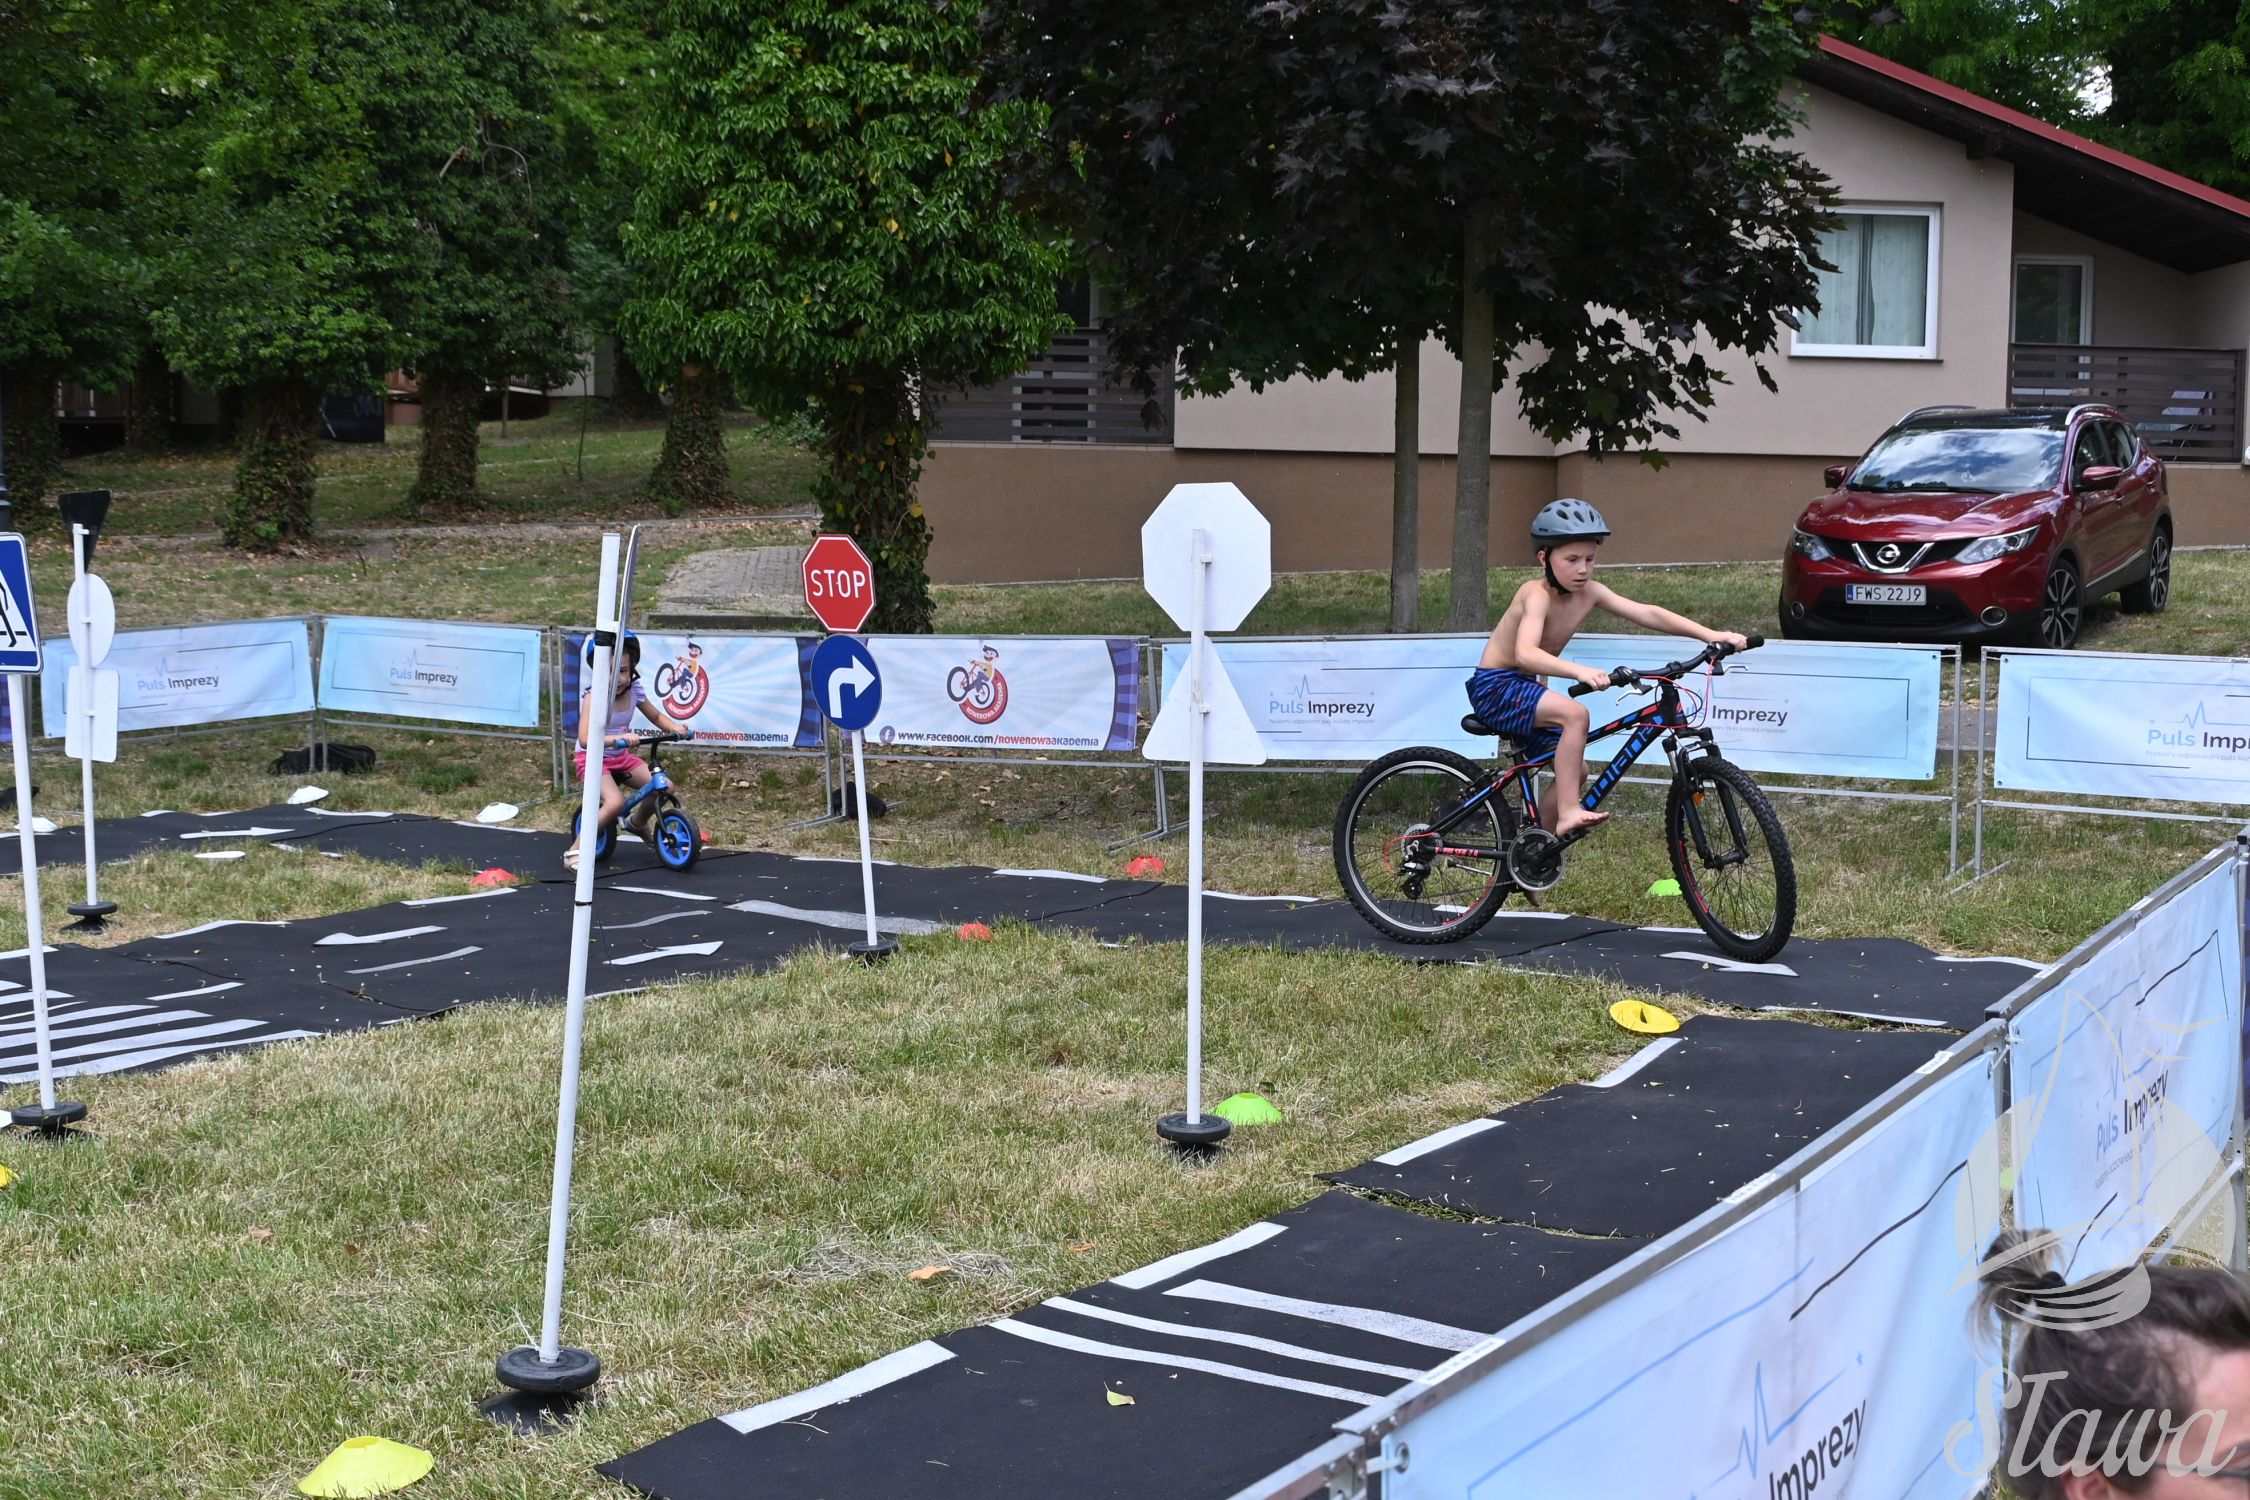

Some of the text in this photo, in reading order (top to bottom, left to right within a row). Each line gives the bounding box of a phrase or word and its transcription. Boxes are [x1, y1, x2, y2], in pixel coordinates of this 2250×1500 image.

[811, 569, 866, 598] STOP
[1855, 586, 1922, 602] FWS 22J9
[137, 676, 219, 691] Puls Imprezy
[390, 667, 458, 686] Puls Imprezy
[1269, 700, 1375, 718] Puls Imprezy
[1712, 704, 1788, 727] Imprezy
[2147, 728, 2250, 753] Puls Imp
[2096, 1111, 2119, 1162] Puls
[2124, 1069, 2168, 1135] Imprezy
